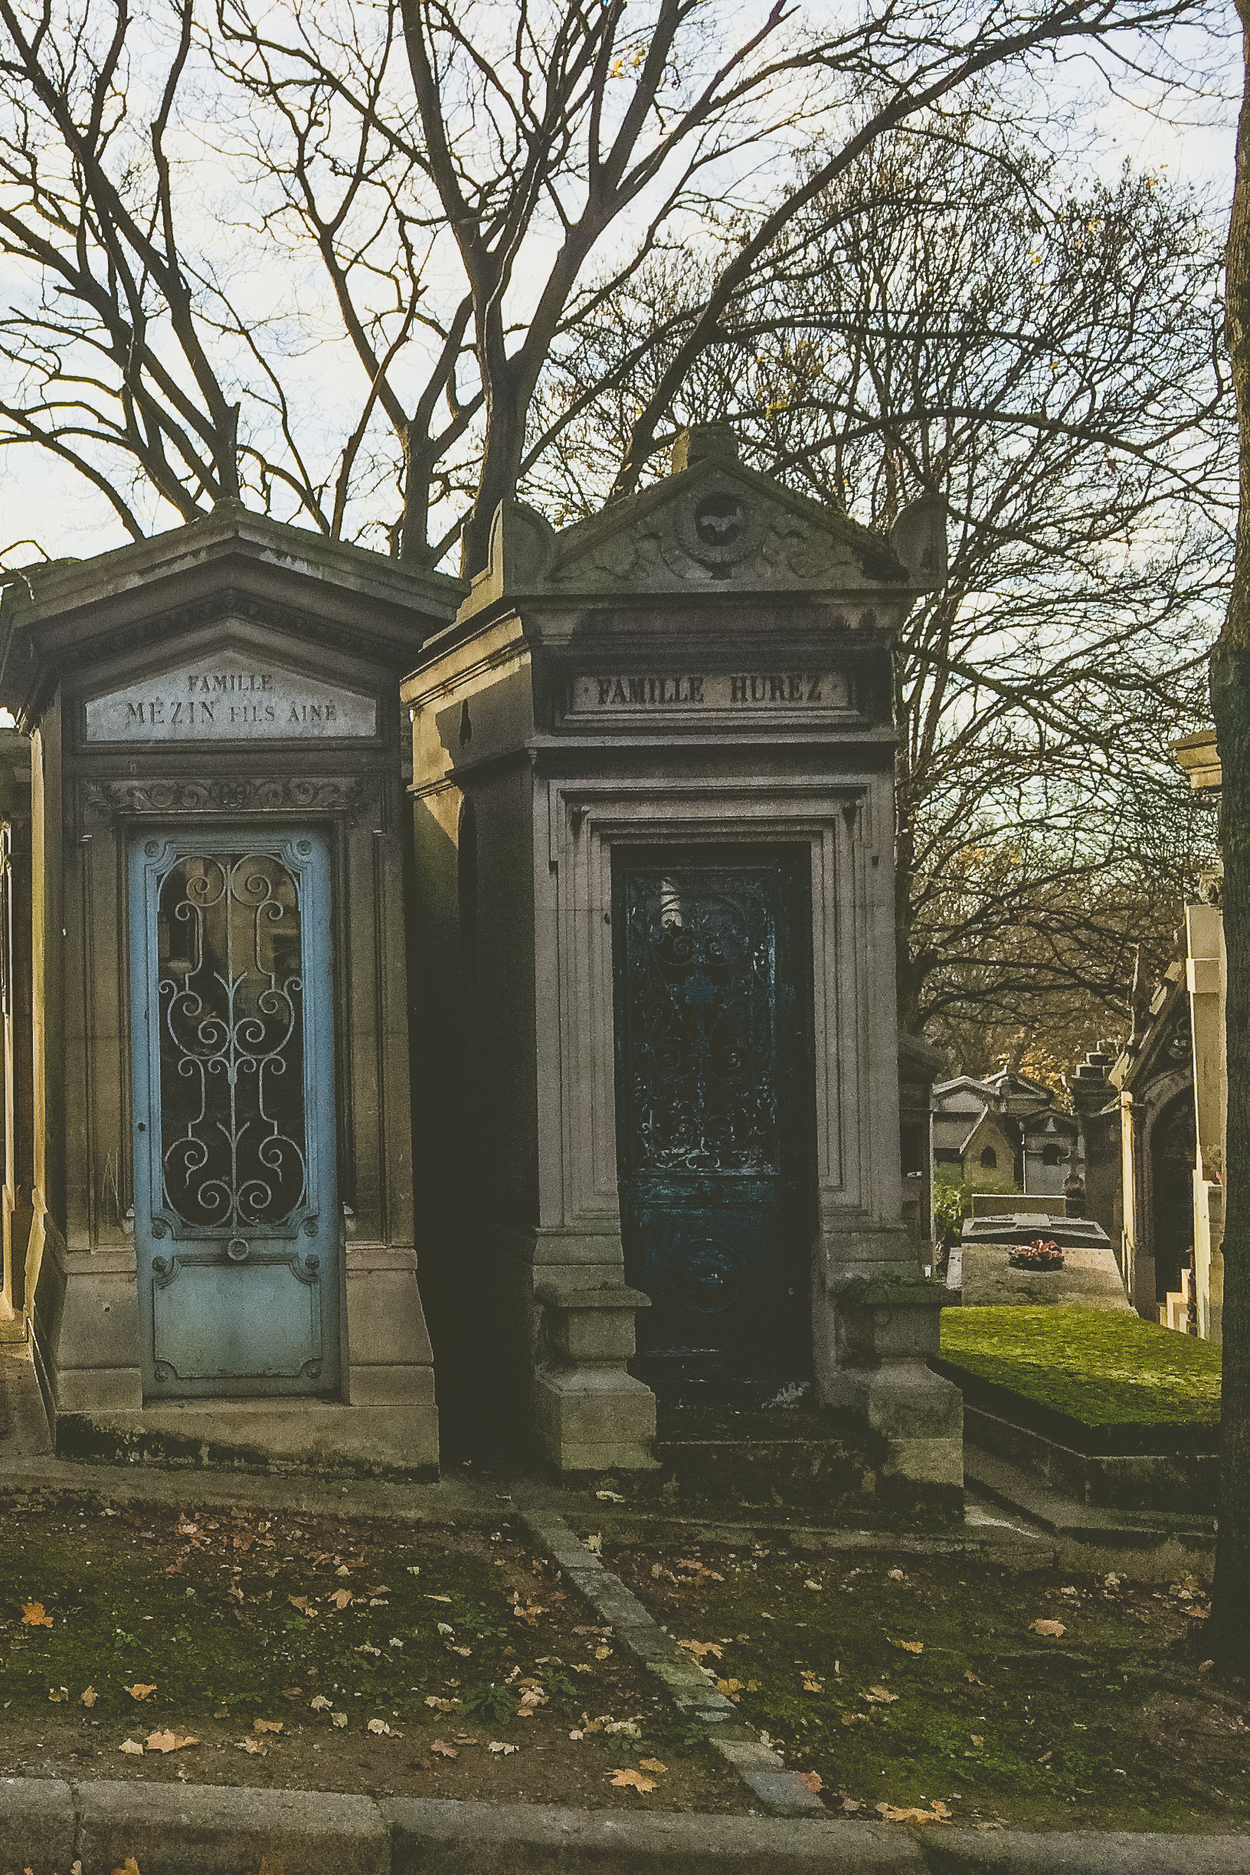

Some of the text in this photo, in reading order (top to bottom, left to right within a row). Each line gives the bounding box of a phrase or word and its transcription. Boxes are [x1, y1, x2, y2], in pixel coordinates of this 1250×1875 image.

[187, 674, 274, 692] FAMILLE
[596, 674, 823, 704] FAMILLE HUREZ
[228, 704, 276, 722] FILS
